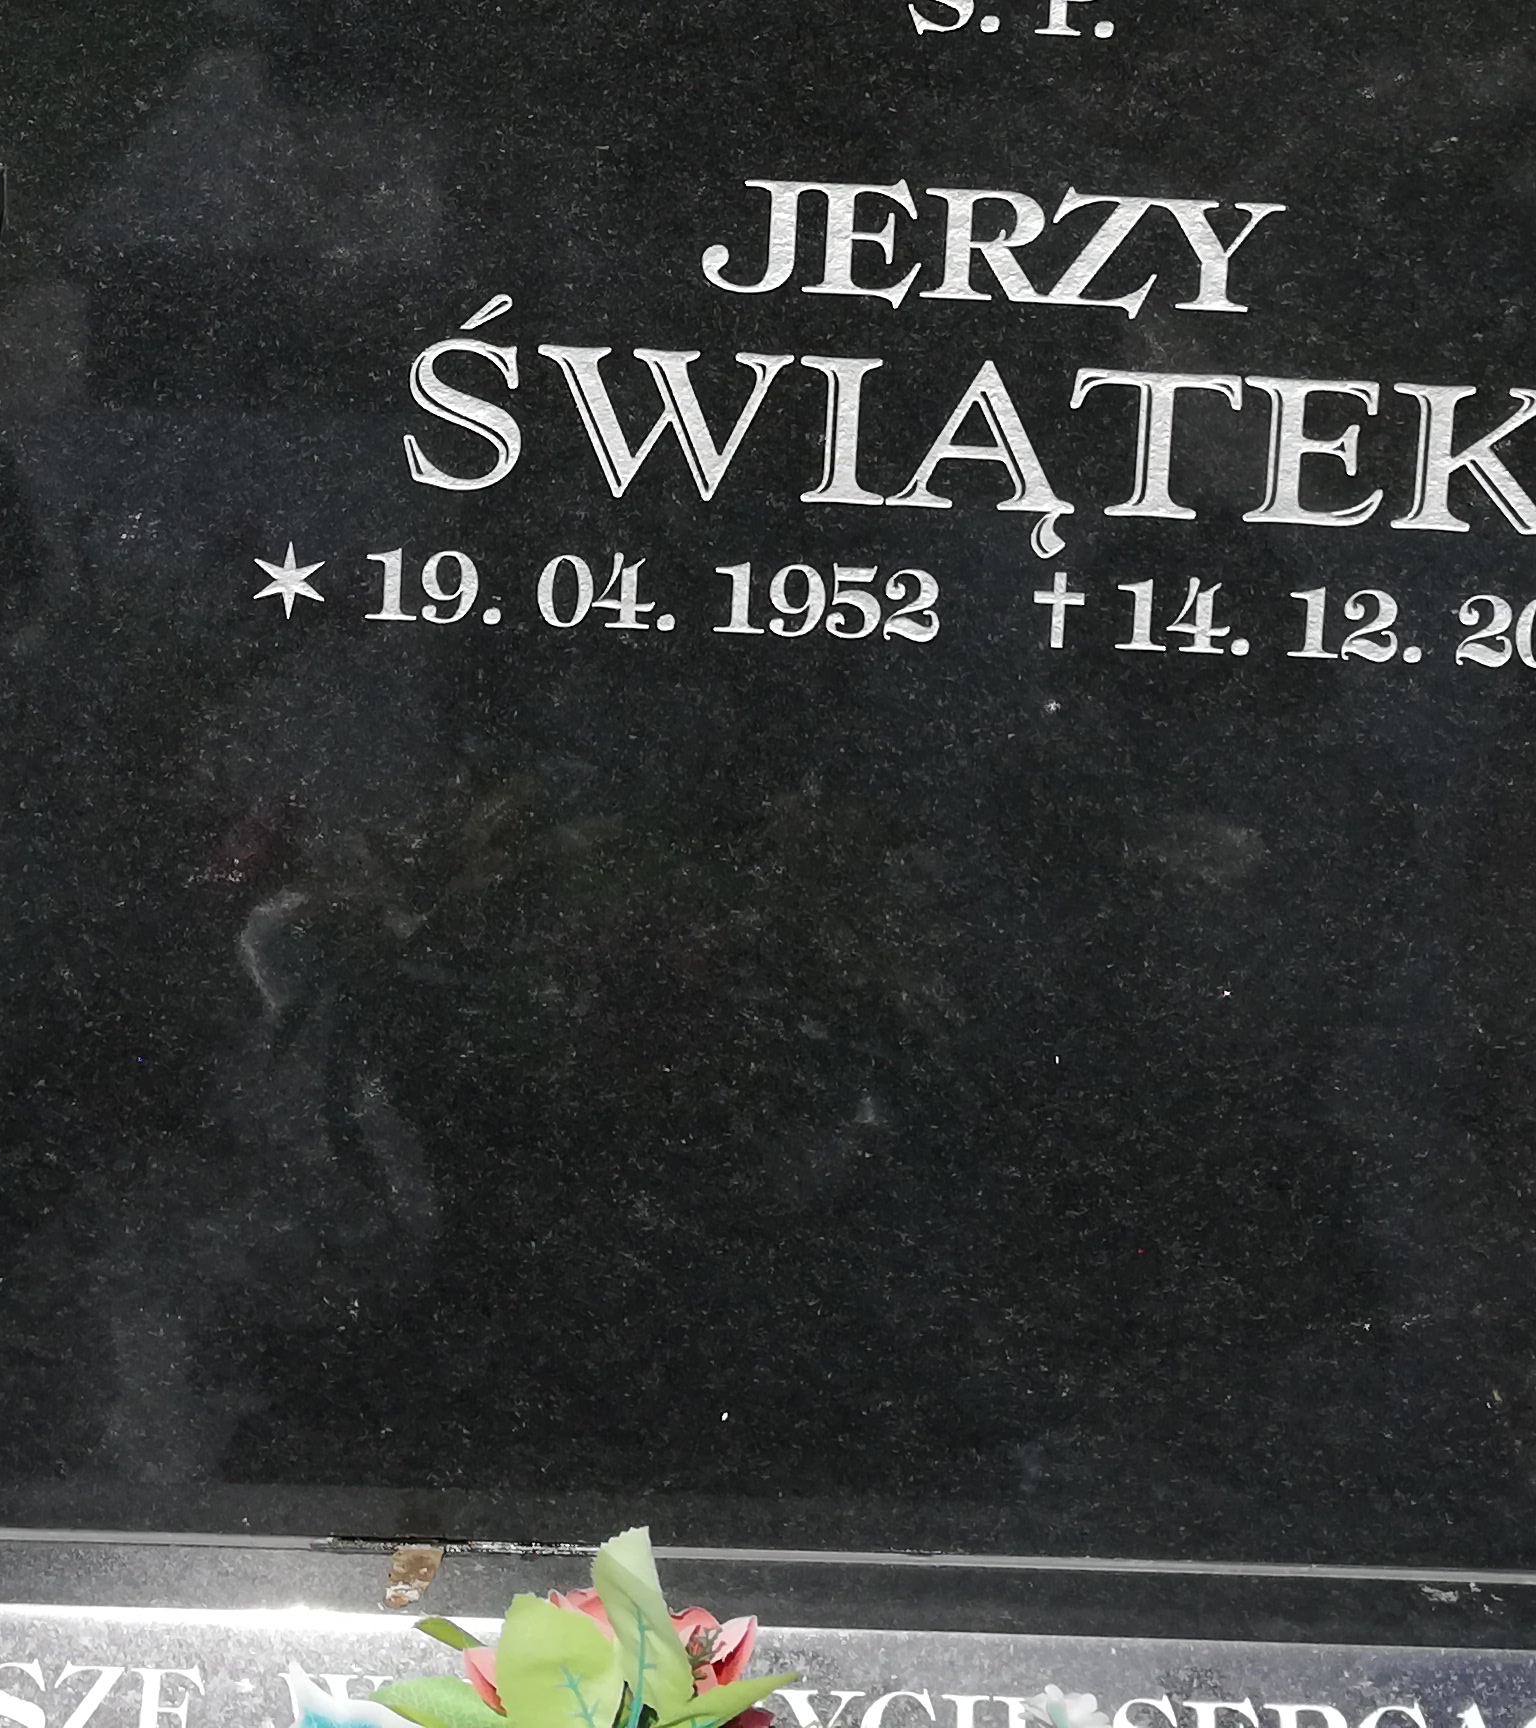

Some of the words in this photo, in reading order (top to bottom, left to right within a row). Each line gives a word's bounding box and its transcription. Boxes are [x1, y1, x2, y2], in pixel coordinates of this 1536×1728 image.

[702, 178, 1287, 320] JERZY
[364, 547, 502, 625] 19.
[537, 552, 676, 632] 04.
[712, 561, 940, 643] 1952
[1114, 577, 1250, 656] 14.
[1286, 586, 1422, 664] 12.
